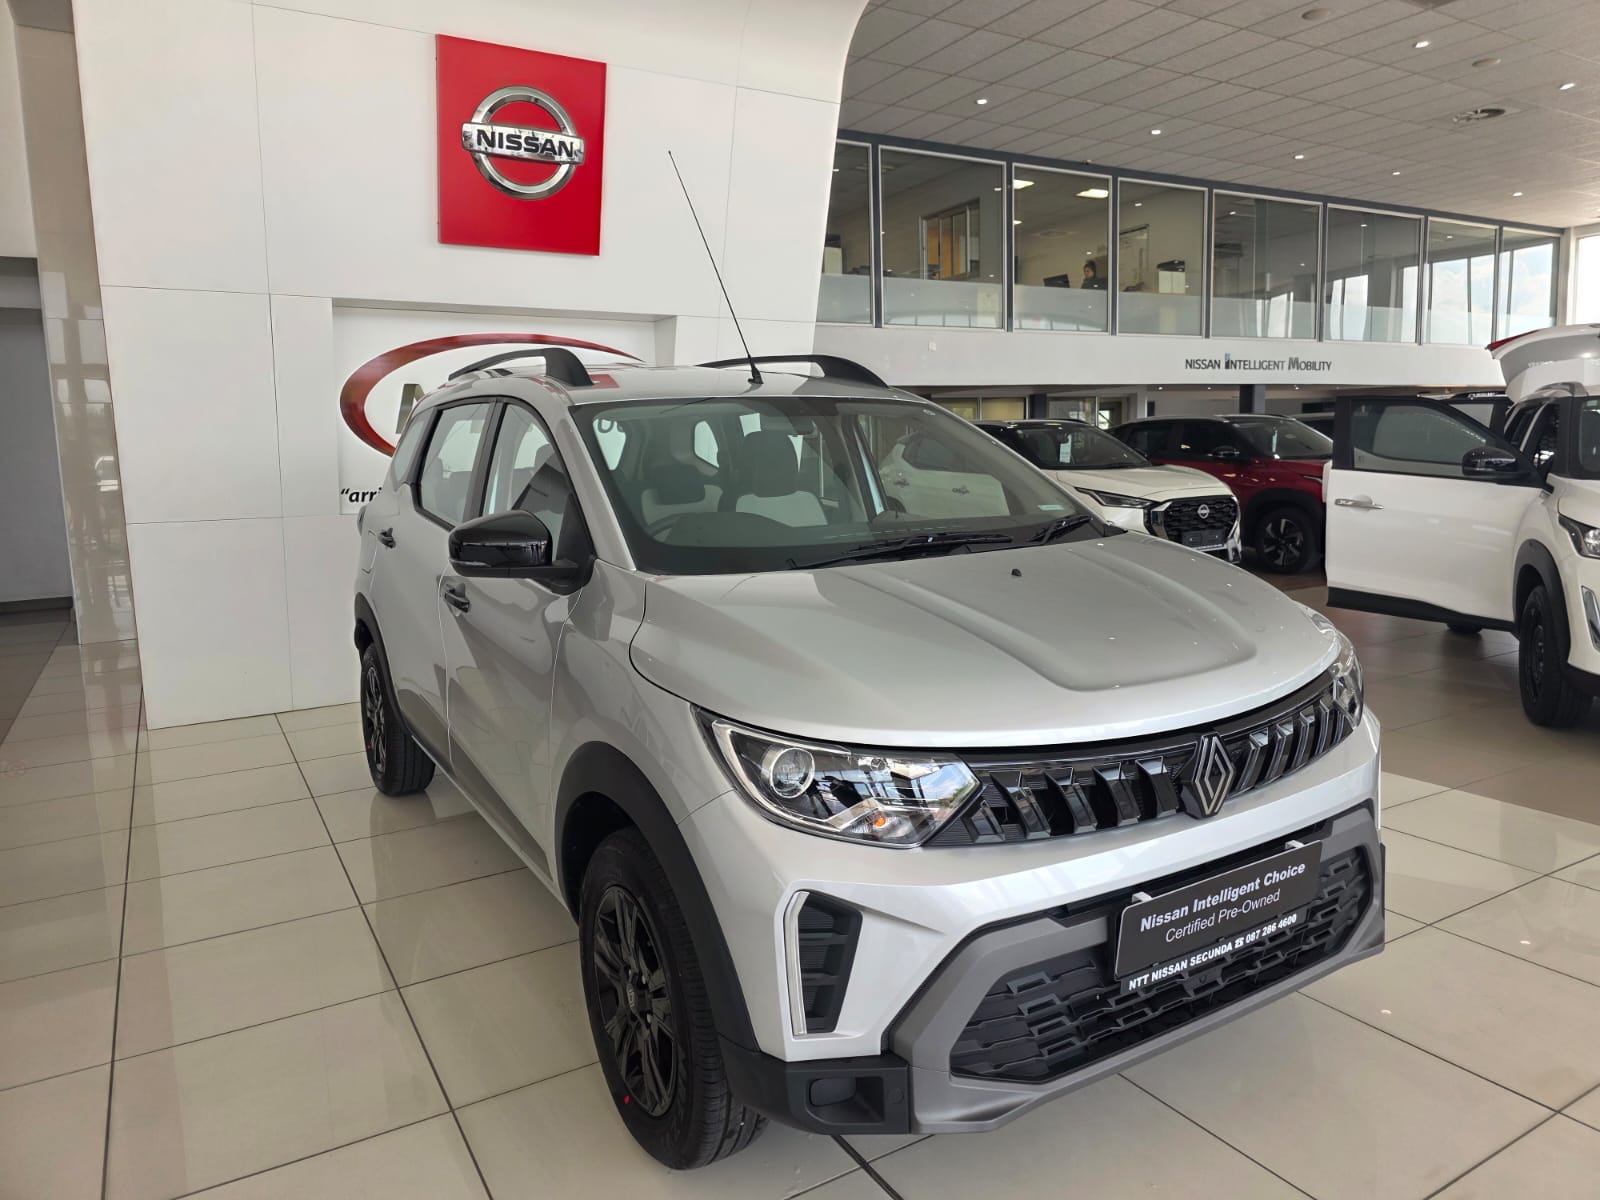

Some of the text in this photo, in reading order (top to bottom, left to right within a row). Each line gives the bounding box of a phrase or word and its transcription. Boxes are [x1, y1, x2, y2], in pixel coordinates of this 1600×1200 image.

[476, 128, 574, 158] NISSAN
[1185, 359, 1221, 370] NISSAN
[1288, 357, 1332, 371] MOBILITY
[1140, 863, 1306, 932] Nissan Intelligent Choice
[1165, 888, 1281, 943] Certified Pre-Owned
[1128, 974, 1150, 991] NTT
[1151, 959, 1188, 982] NISSAN
[1190, 942, 1233, 966] SECUNDA
[1277, 913, 1298, 928] 4600
